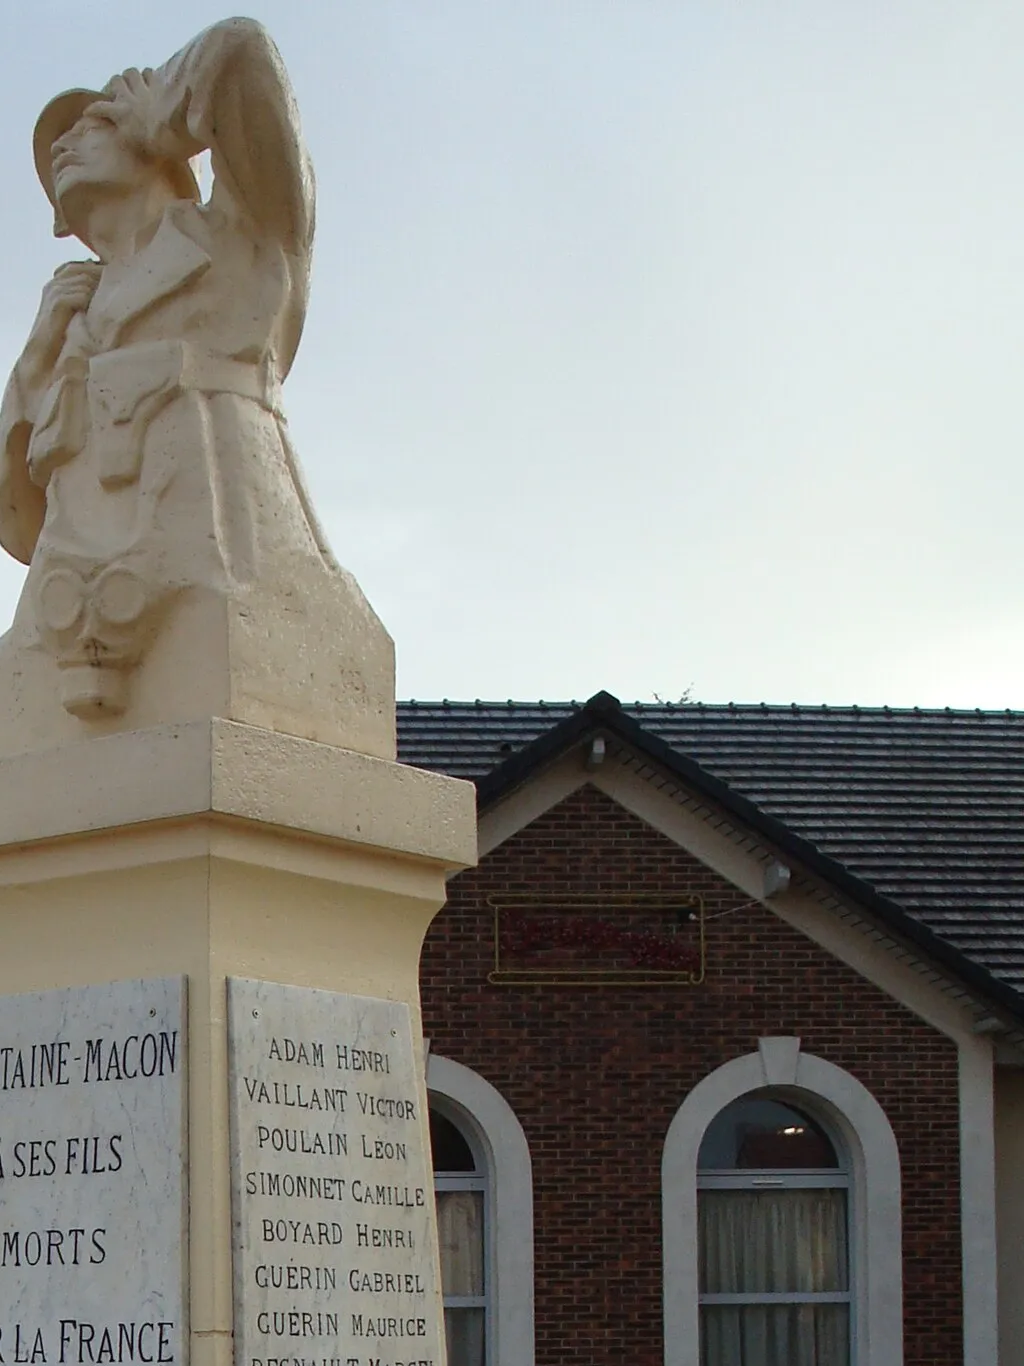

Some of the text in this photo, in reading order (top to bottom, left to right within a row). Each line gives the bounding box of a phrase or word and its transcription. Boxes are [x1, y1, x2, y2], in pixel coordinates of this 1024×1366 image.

[268, 1037, 390, 1074] ADAM HENRI
[243, 1077, 416, 1121] VAILLANT VICTOR
[13, 1140, 56, 1178] SES
[65, 1135, 123, 1175] FILS
[258, 1126, 348, 1156] POULAIN
[246, 1172, 425, 1207] SIMONNET CAMILLE
[1, 1228, 107, 1267] MORTS
[262, 1219, 413, 1248] BOYARD HENRI
[255, 1258, 425, 1293] GUÉRIN GABRIEL
[257, 1306, 426, 1337] GUÉRIN MAURICE
[14, 1324, 47, 1364] LA
[59, 1319, 174, 1364] FRANCE
